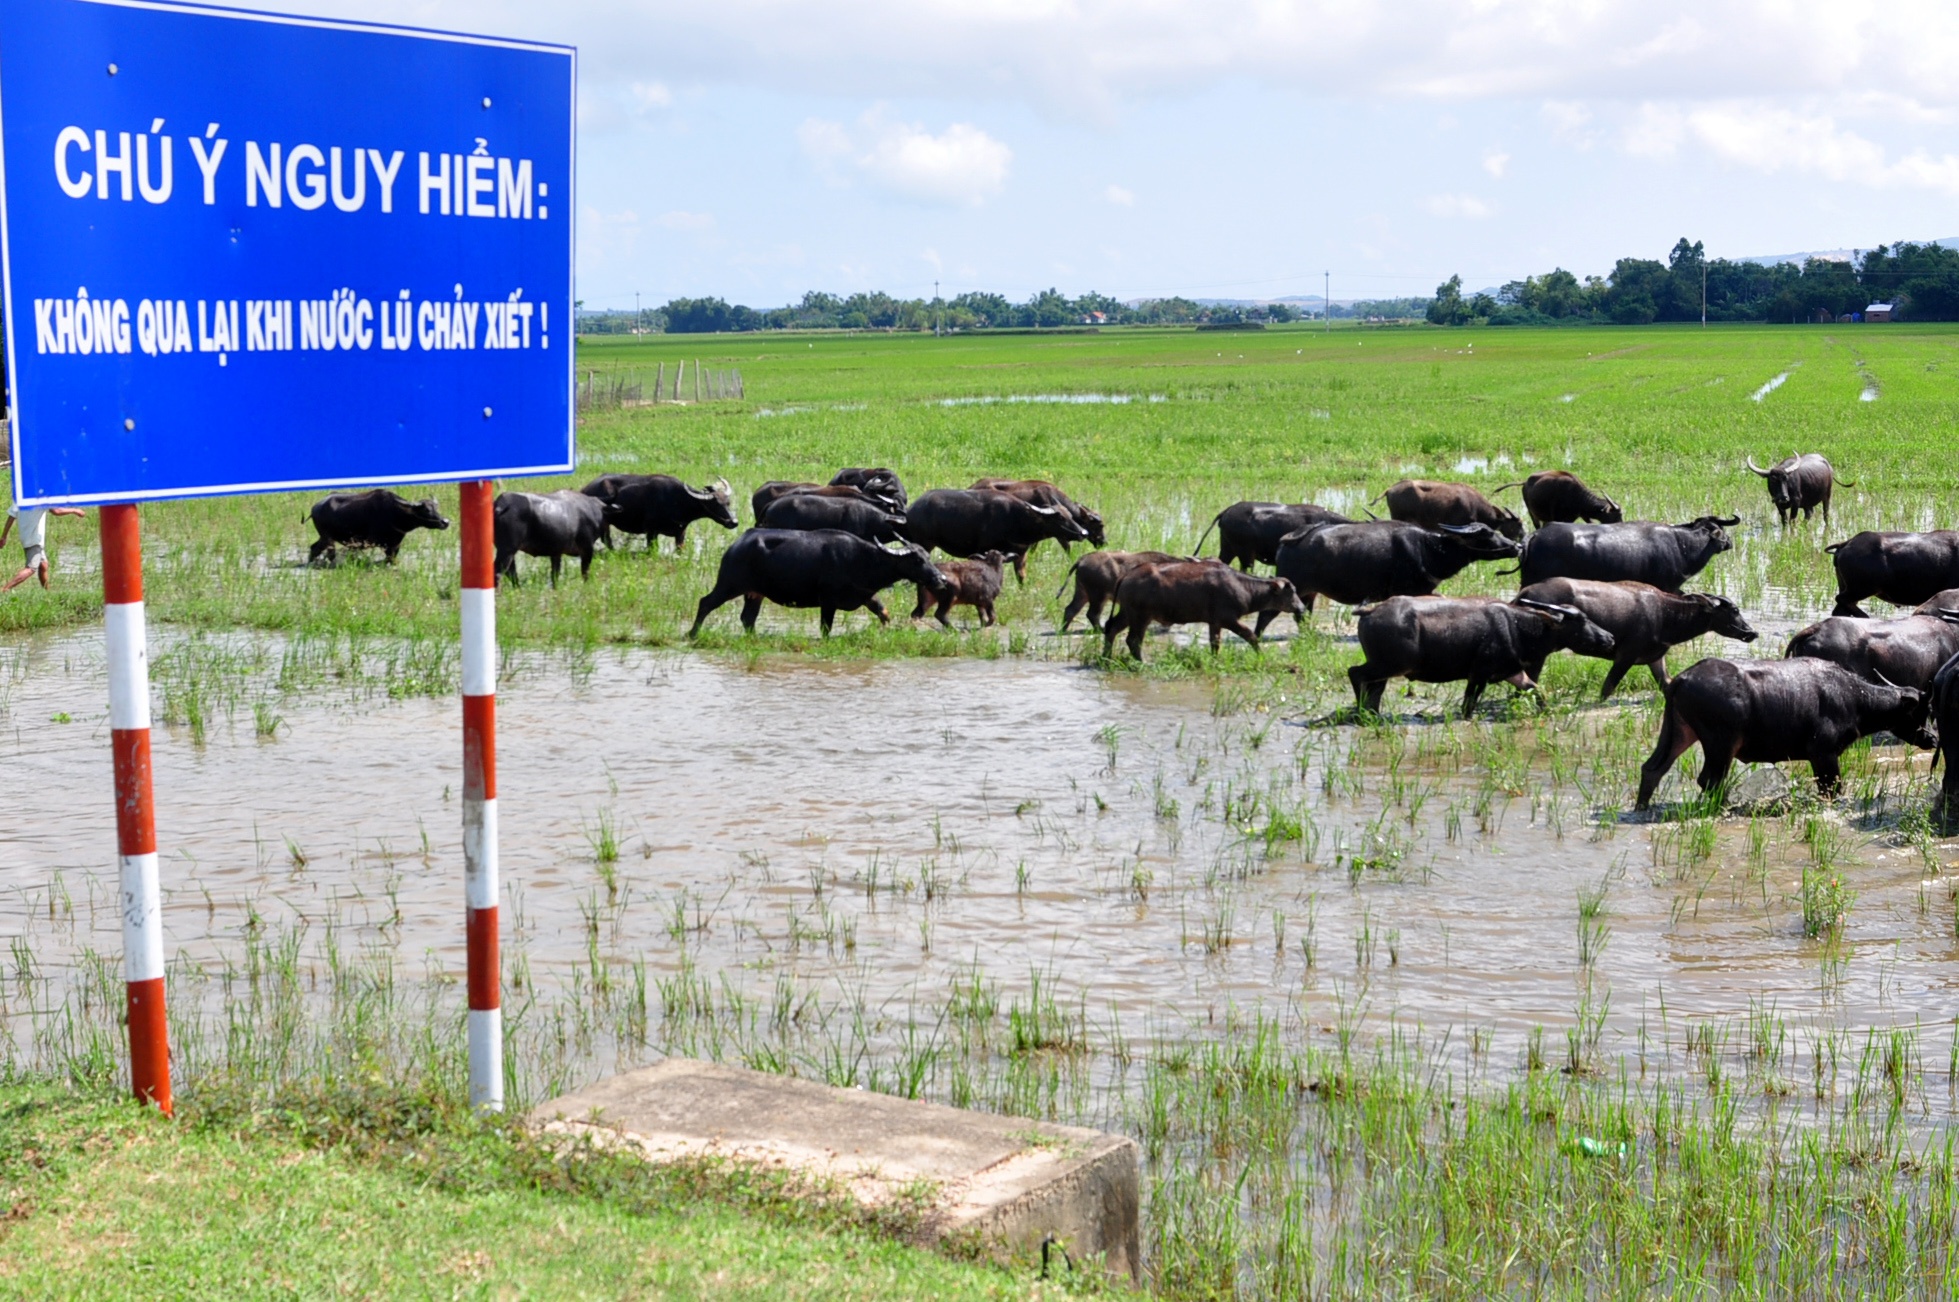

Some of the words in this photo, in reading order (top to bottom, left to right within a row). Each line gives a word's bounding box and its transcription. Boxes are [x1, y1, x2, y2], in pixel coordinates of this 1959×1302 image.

[54, 118, 173, 205] CHÚ
[189, 122, 228, 205] Ý
[246, 141, 404, 214] NGUY
[418, 137, 548, 220] HIỂM:
[34, 285, 131, 355] KHÔNG
[137, 299, 193, 356] QUA
[198, 300, 240, 367] LẠI
[246, 300, 293, 352] KHI
[299, 286, 373, 352] NƯỚC
[381, 288, 413, 351] LŨ
[417, 283, 480, 351] CHẢY
[484, 288, 533, 350] XIẾT
[541, 301, 548, 350] !
